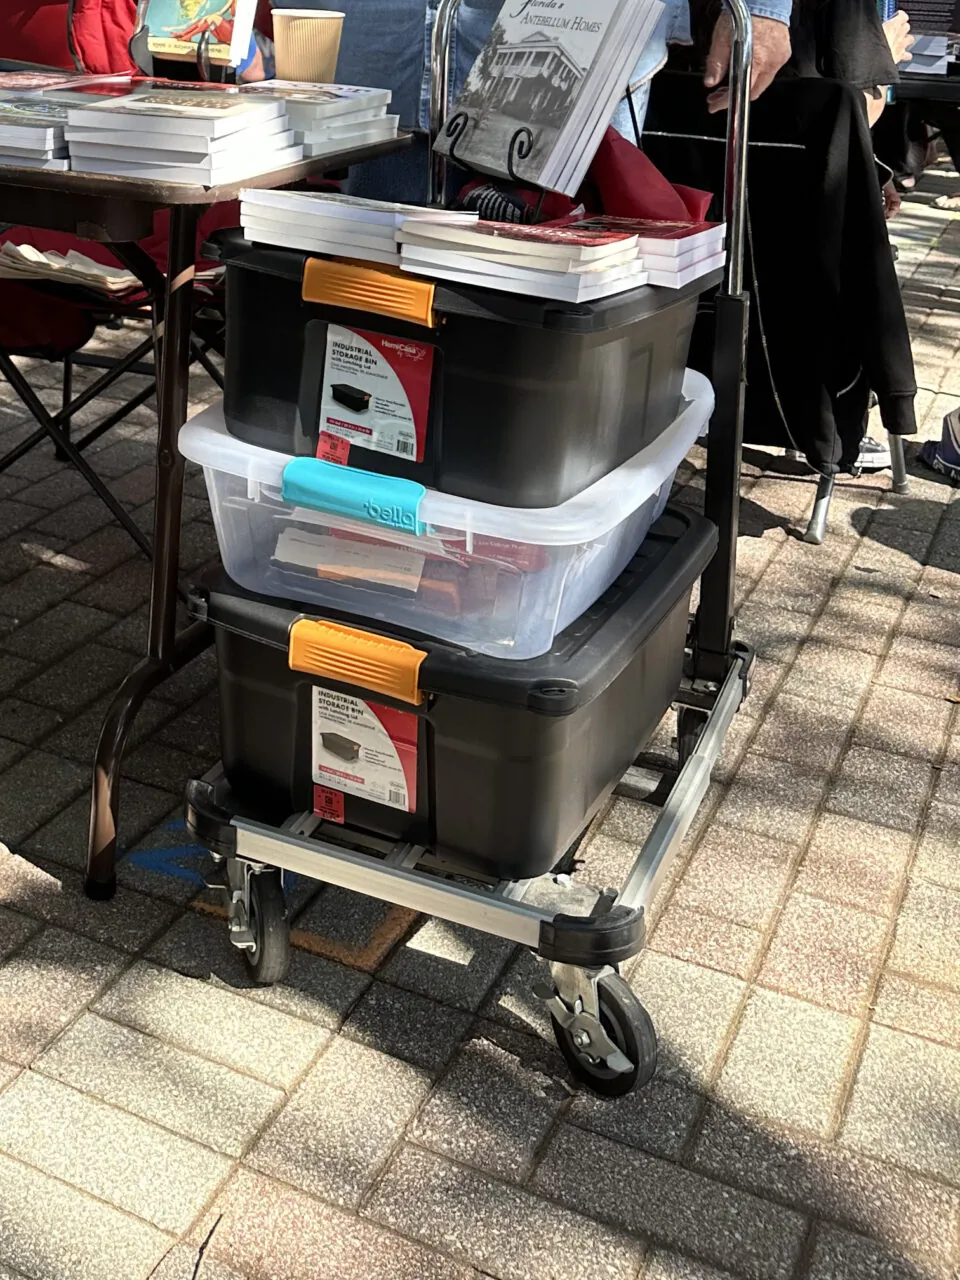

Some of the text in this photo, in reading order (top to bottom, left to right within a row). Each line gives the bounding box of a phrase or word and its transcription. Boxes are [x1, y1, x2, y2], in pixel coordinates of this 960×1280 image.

[569, 16, 603, 33] HOMES
[332, 341, 373, 357] INDUSTRIAL
[332, 349, 378, 366] STORAGE BIN
[364, 498, 415, 527] bella
[318, 690, 359, 706] INDUSTRIAL
[318, 698, 349, 711] STORAGE
